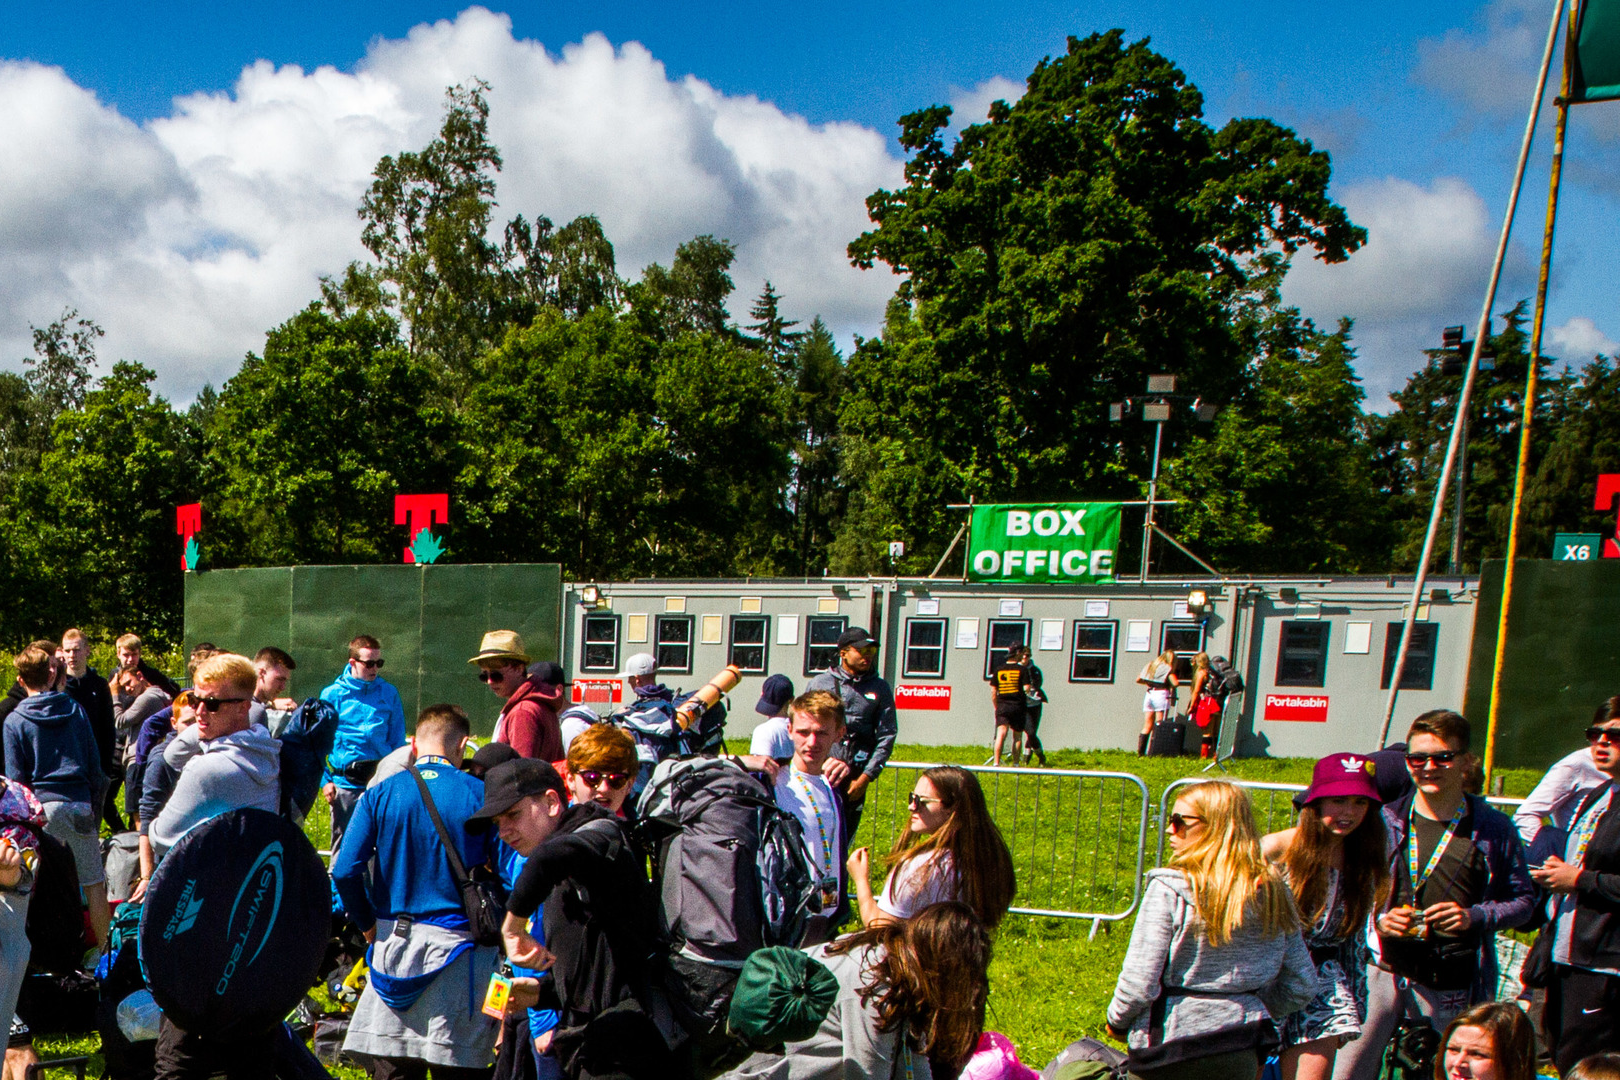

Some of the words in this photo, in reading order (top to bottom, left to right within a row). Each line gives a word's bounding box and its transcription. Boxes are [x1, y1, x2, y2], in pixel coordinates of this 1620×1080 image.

[1006, 509, 1087, 536] BOX
[973, 549, 1113, 576] OFFICE
[1562, 544, 1591, 561] X6
[896, 686, 950, 698] Portakabin
[1266, 696, 1327, 708] Portakabin
[163, 878, 196, 943] TRESPASS
